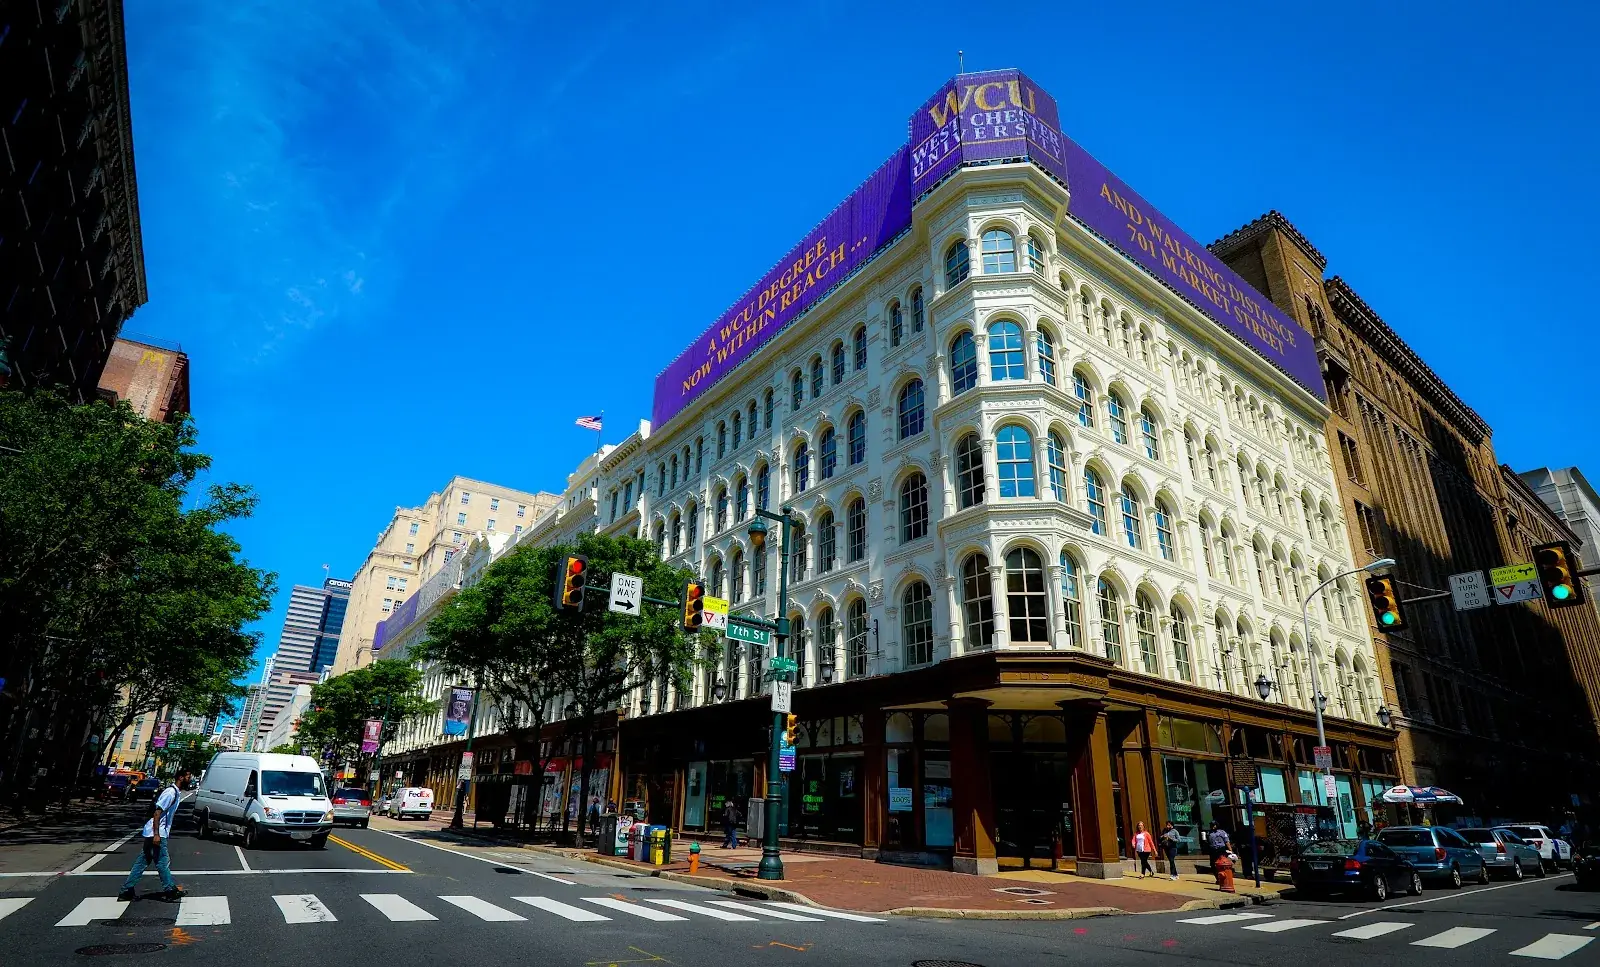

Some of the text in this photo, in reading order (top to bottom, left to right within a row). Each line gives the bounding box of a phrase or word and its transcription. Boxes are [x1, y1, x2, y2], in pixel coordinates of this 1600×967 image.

[929, 80, 1036, 129] WCU
[913, 110, 1061, 164] WEST CHESTER
[913, 124, 1061, 178] UNIVERSITY
[1100, 183, 1297, 348] AND WALKING DISTANCE
[1127, 224, 1285, 356] 701 MARKET STREET
[681, 357, 714, 396] NOW
[717, 303, 777, 364] WITHIN
[780, 242, 846, 312] REACH
[707, 236, 827, 355] A WCU DEGREE
[617, 588, 636, 599] WAY
[619, 577, 636, 589] ONE
[1458, 583, 1478, 591] TURN
[1459, 576, 1474, 584] NO
[733, 625, 765, 640] 7th St
